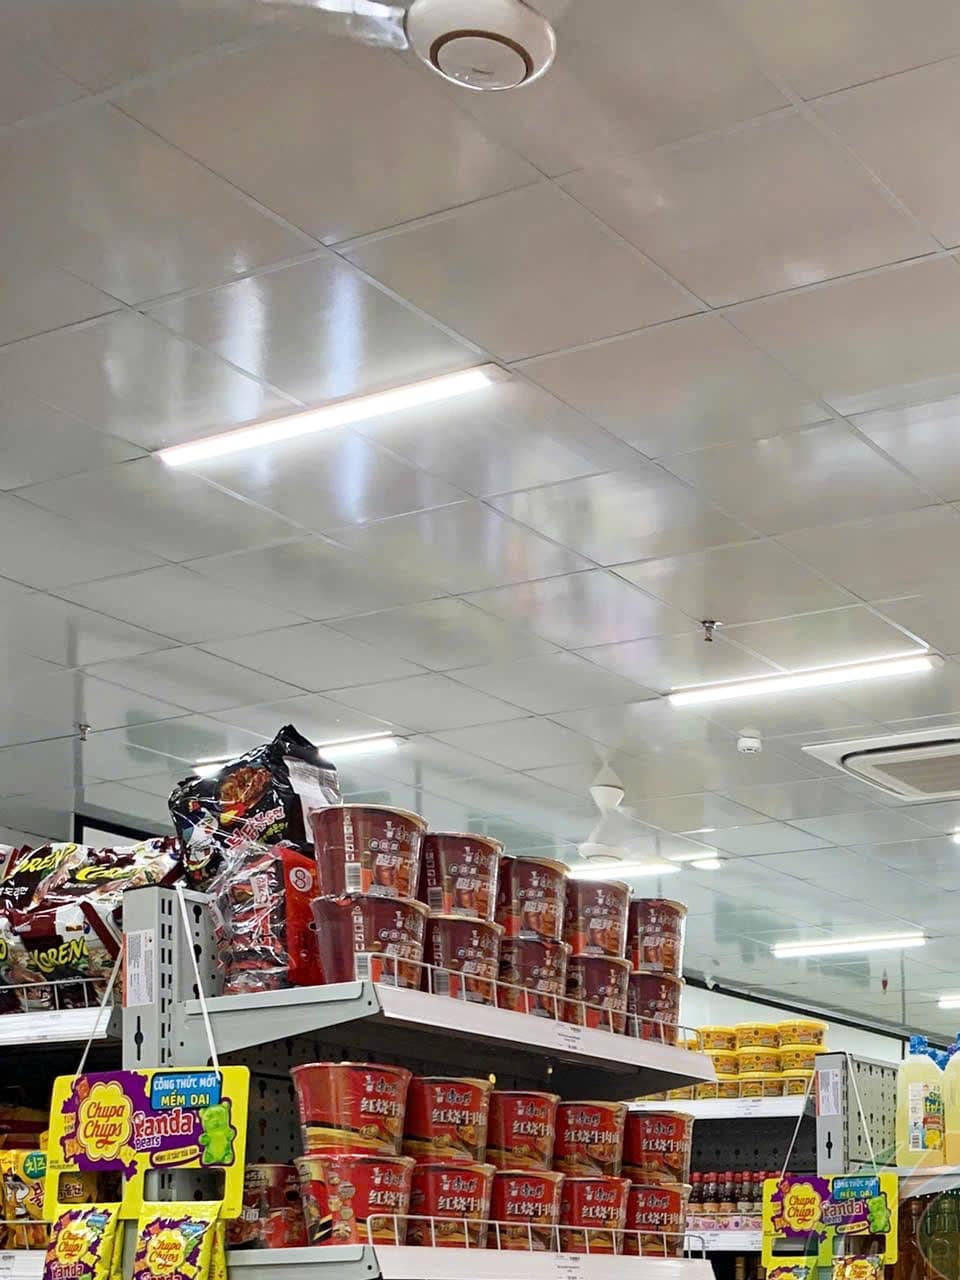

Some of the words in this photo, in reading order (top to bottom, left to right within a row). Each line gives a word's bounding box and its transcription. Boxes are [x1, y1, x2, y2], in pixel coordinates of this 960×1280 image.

[153, 1077, 174, 1091] CÔNG
[176, 1074, 198, 1089] THỨC
[190, 1094, 210, 1105] DAI
[86, 1101, 126, 1124] Chupa
[132, 1108, 194, 1138] Panda
[83, 1119, 123, 1142] Chups
